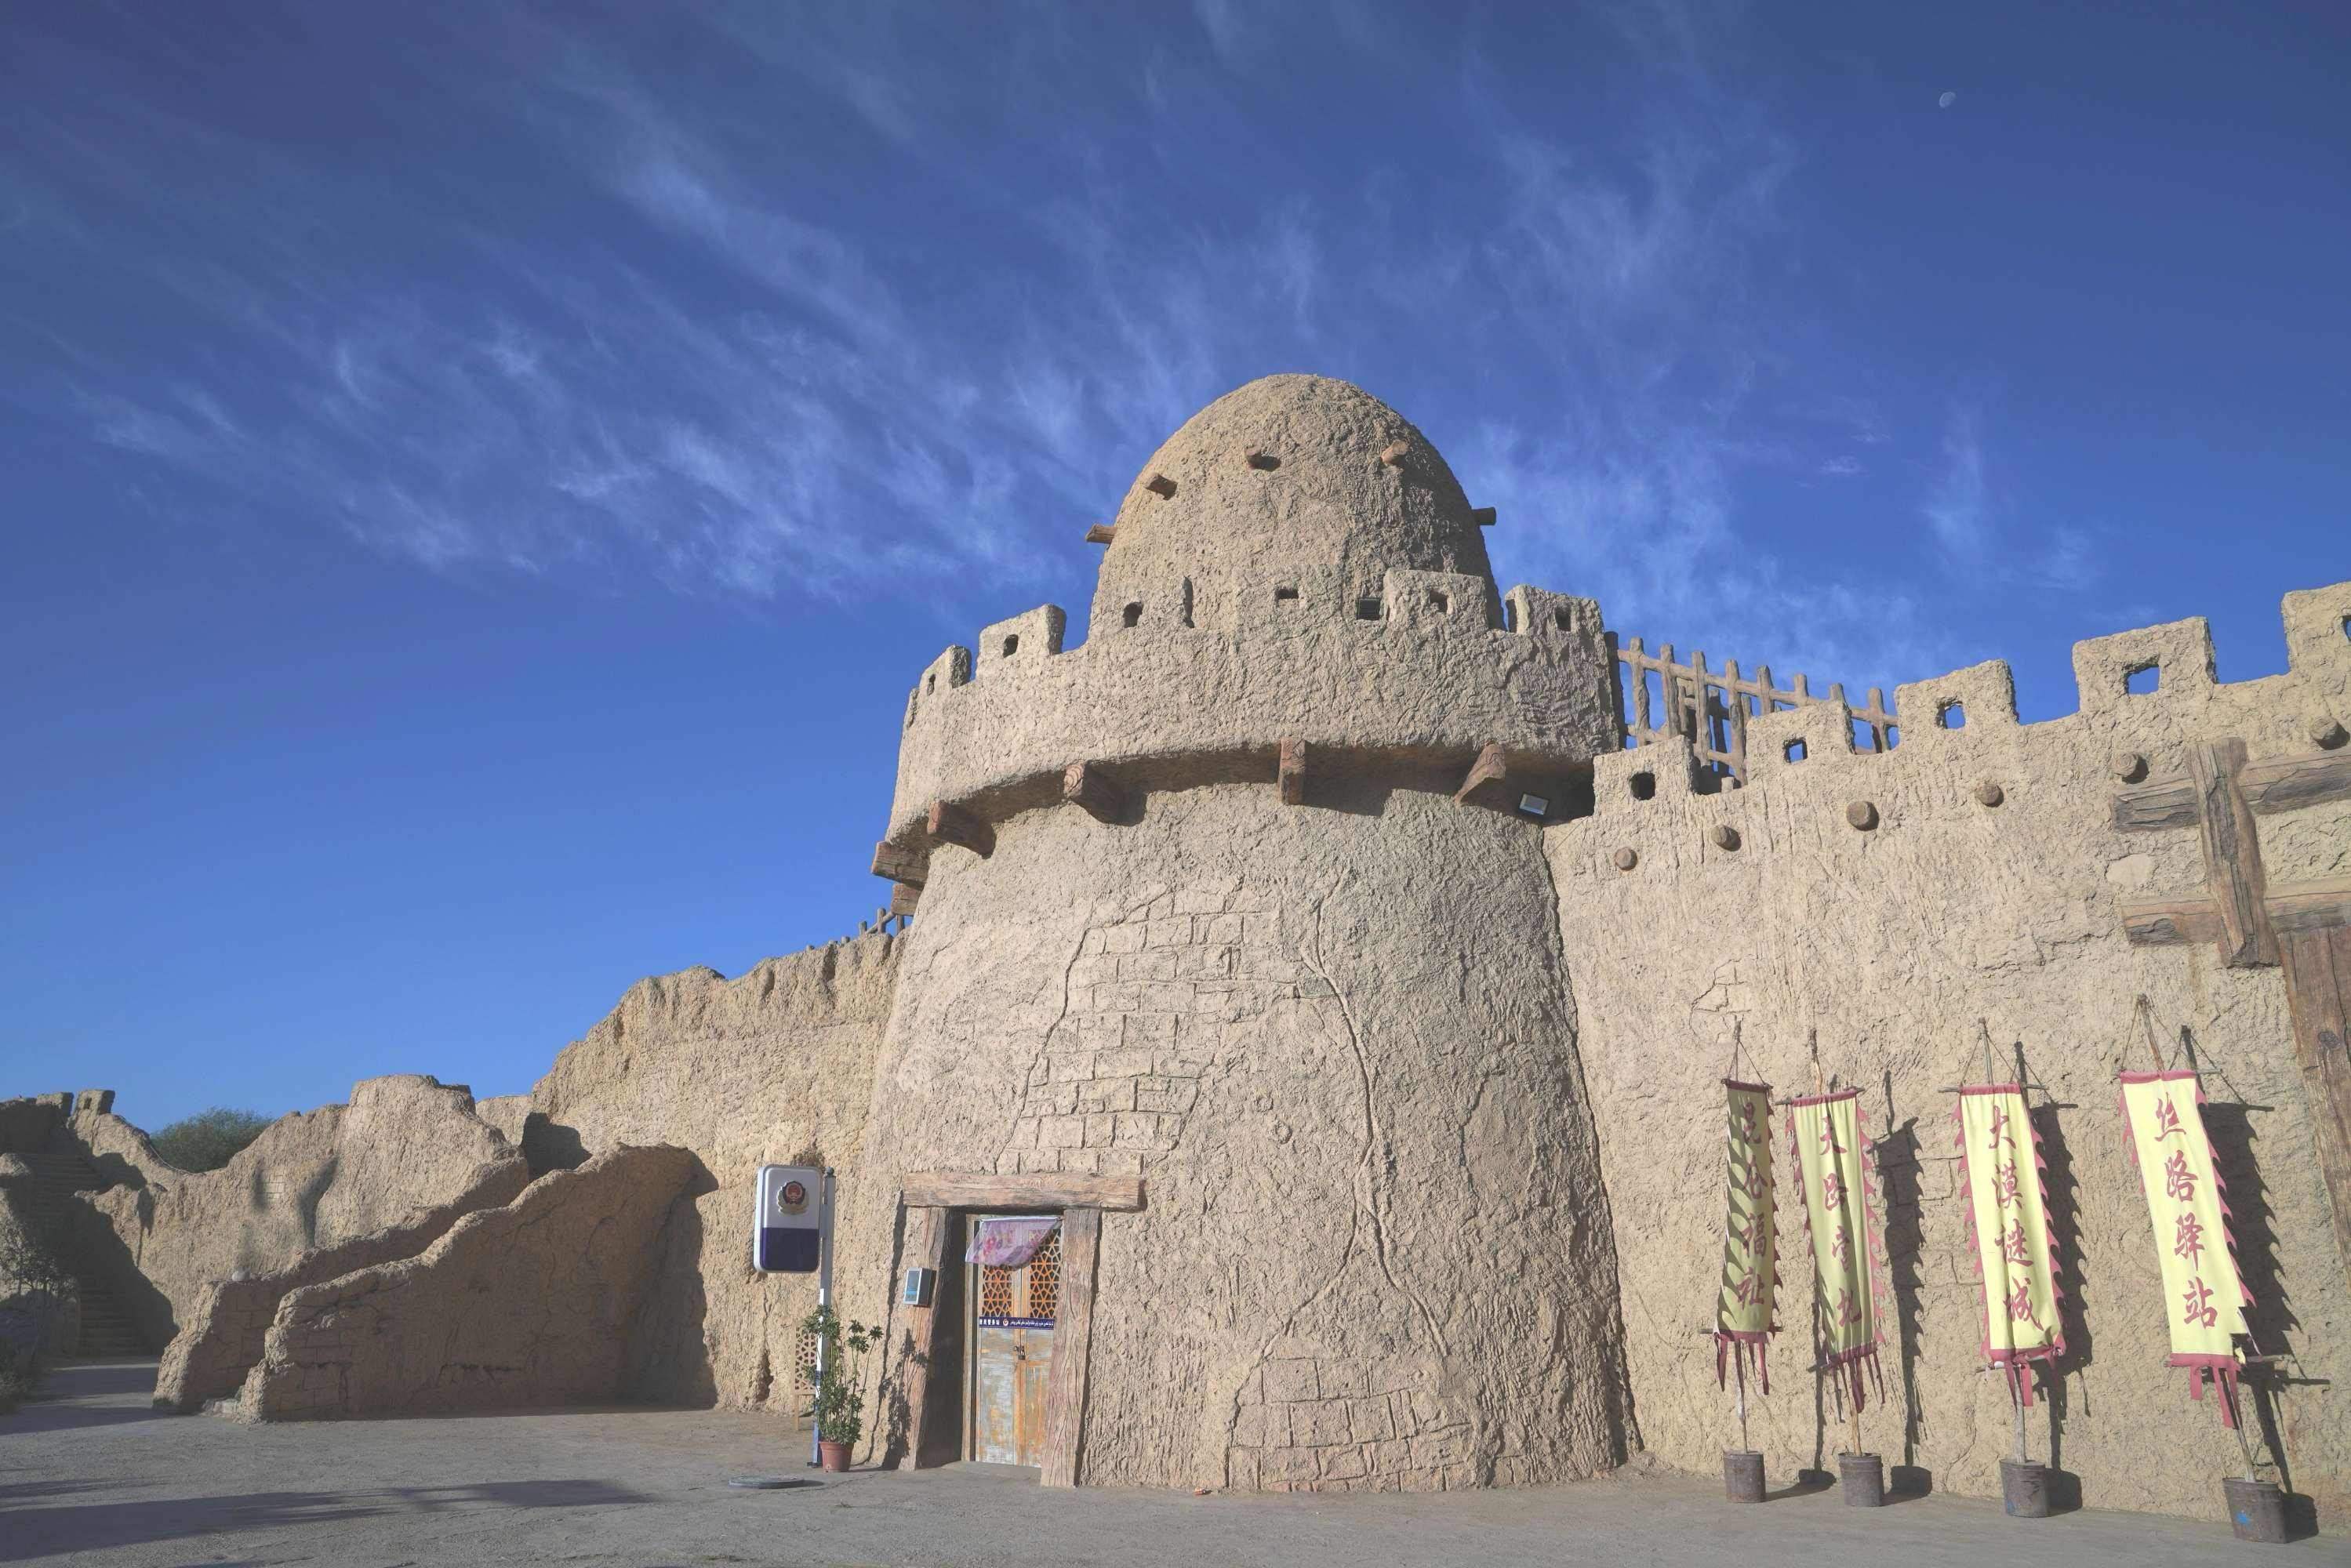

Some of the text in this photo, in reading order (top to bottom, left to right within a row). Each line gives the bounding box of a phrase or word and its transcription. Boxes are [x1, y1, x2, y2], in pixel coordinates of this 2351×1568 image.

[1736, 1102, 1768, 1310] 昆仑福祉
[1989, 1105, 2044, 1330] 大漠谜城
[2154, 1092, 2218, 1329] 丝路驿站
